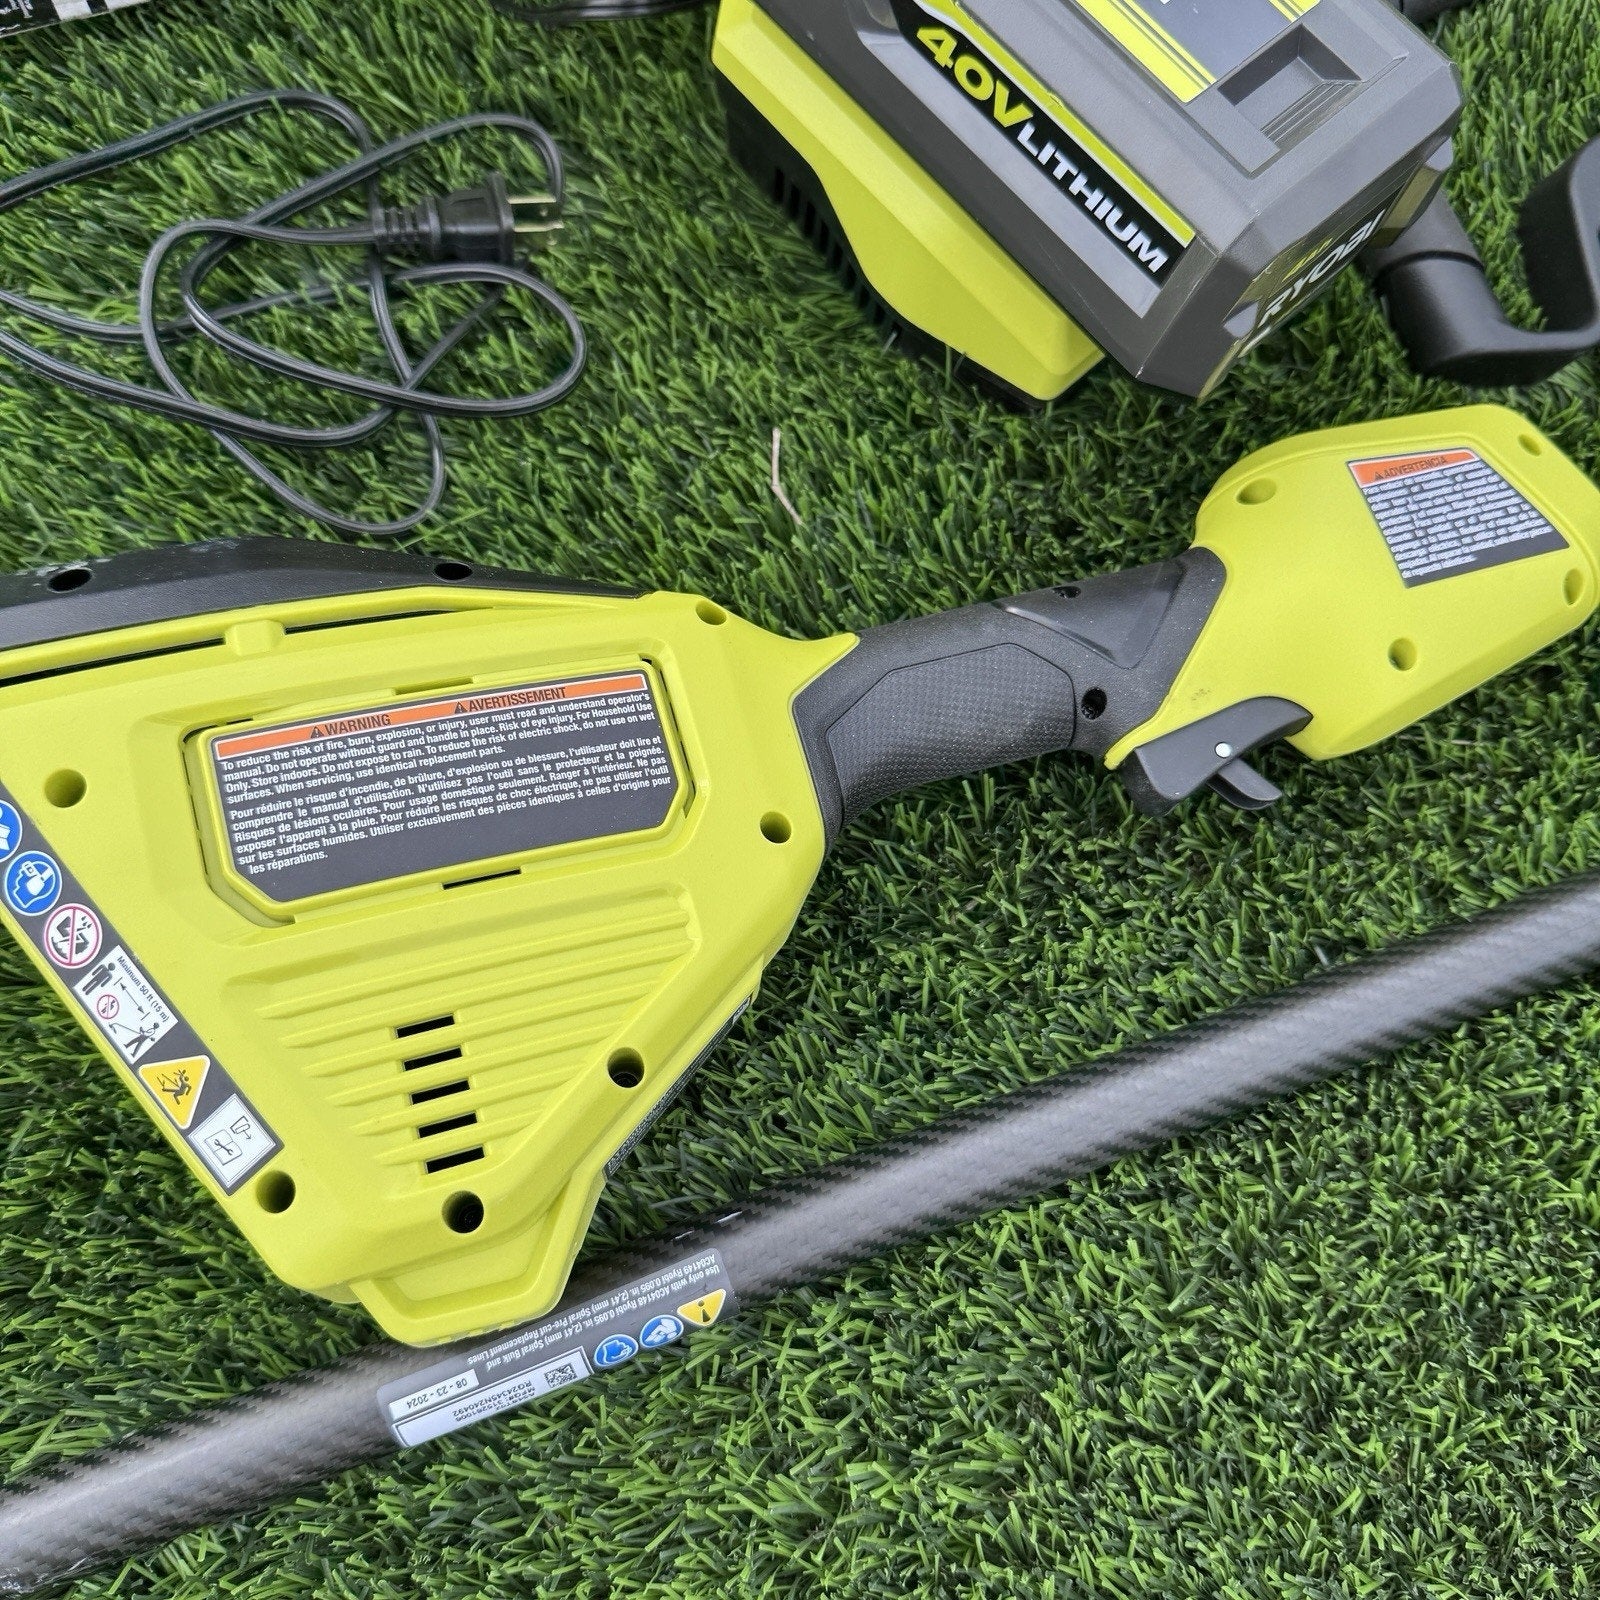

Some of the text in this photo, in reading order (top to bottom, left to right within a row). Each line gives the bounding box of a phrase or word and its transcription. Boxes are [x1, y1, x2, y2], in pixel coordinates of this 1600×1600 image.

[916, 26, 1169, 273] 40V LITHIUM
[1257, 209, 1386, 328] RYOBI
[1384, 456, 1449, 478] ADVERTENCIA
[324, 687, 566, 736] WARNING AVERTISSEMENT
[220, 692, 650, 771] To reduce the risk of fire, burn, explosion, or injury, user must read and understand operator's
[222, 703, 652, 782] manual. Do not operate without guard and handle place. Risk of eye injury. For Household Use
[224, 712, 655, 793] Only. Store indoors. Do not expose rain. To reduce the risk electric shock, not use wet
[226, 745, 506, 804] surfaces. When servicing, use identical replacement parts.
[229, 808, 254, 820] Pour
[255, 800, 292, 814] réduire
[304, 792, 337, 804] risque
[407, 772, 446, 786] brûlure,
[447, 762, 500, 777] d'explosion
[527, 751, 569, 764] blessure,
[568, 743, 618, 757] l'utilisateur
[619, 739, 636, 749] doit
[636, 738, 651, 746] lire
[231, 812, 293, 831] comprendre
[311, 798, 349, 814] manual
[417, 779, 462, 794] N'utilisez
[466, 775, 484, 786] pas
[487, 768, 514, 781] l'outil
[517, 766, 539, 776] sans
[542, 763, 552, 772] le
[555, 756, 600, 772] protecteur
[628, 746, 664, 760] poignée.
[233, 827, 275, 842] Risques
[293, 816, 330, 829] lésions
[332, 806, 381, 821] oculaires.
[382, 800, 406, 811] Pour
[409, 794, 438, 806] usage
[441, 784, 495, 800] domestique
[497, 774, 548, 790] seulement.
[548, 770, 581, 781] Ranger
[636, 756, 648, 767] Ne
[650, 756, 666, 767] pas
[235, 765, 669, 854] exposer l'appareil pluie. Pour réduire les risques choc électrique, pas utiliser l'outil
[237, 777, 671, 865] sur les surfaces humides. Utiliser exclusivement des pièces identiques celles d'origine pour
[248, 851, 328, 874] les réparations.
[117, 956, 170, 1023] Minimum 50 ft (15 m)
[662, 1269, 683, 1284] Ryobi
[689, 1271, 704, 1284] only
[705, 1265, 720, 1276] Use
[671, 1278, 688, 1291] with
[568, 1308, 592, 1324] Spiral
[591, 1300, 610, 1314] mm)
[613, 1299, 638, 1316] Ryobi
[539, 1317, 569, 1337] Pre-cut
[542, 1332, 563, 1345] mm)
[489, 1330, 540, 1358] Replacement
[502, 1349, 521, 1363] Bulk
[521, 1337, 544, 1356] Spiral
[467, 1350, 490, 1365] Lines
[486, 1357, 502, 1372] and
[406, 1377, 468, 1409] 08 23 2024
